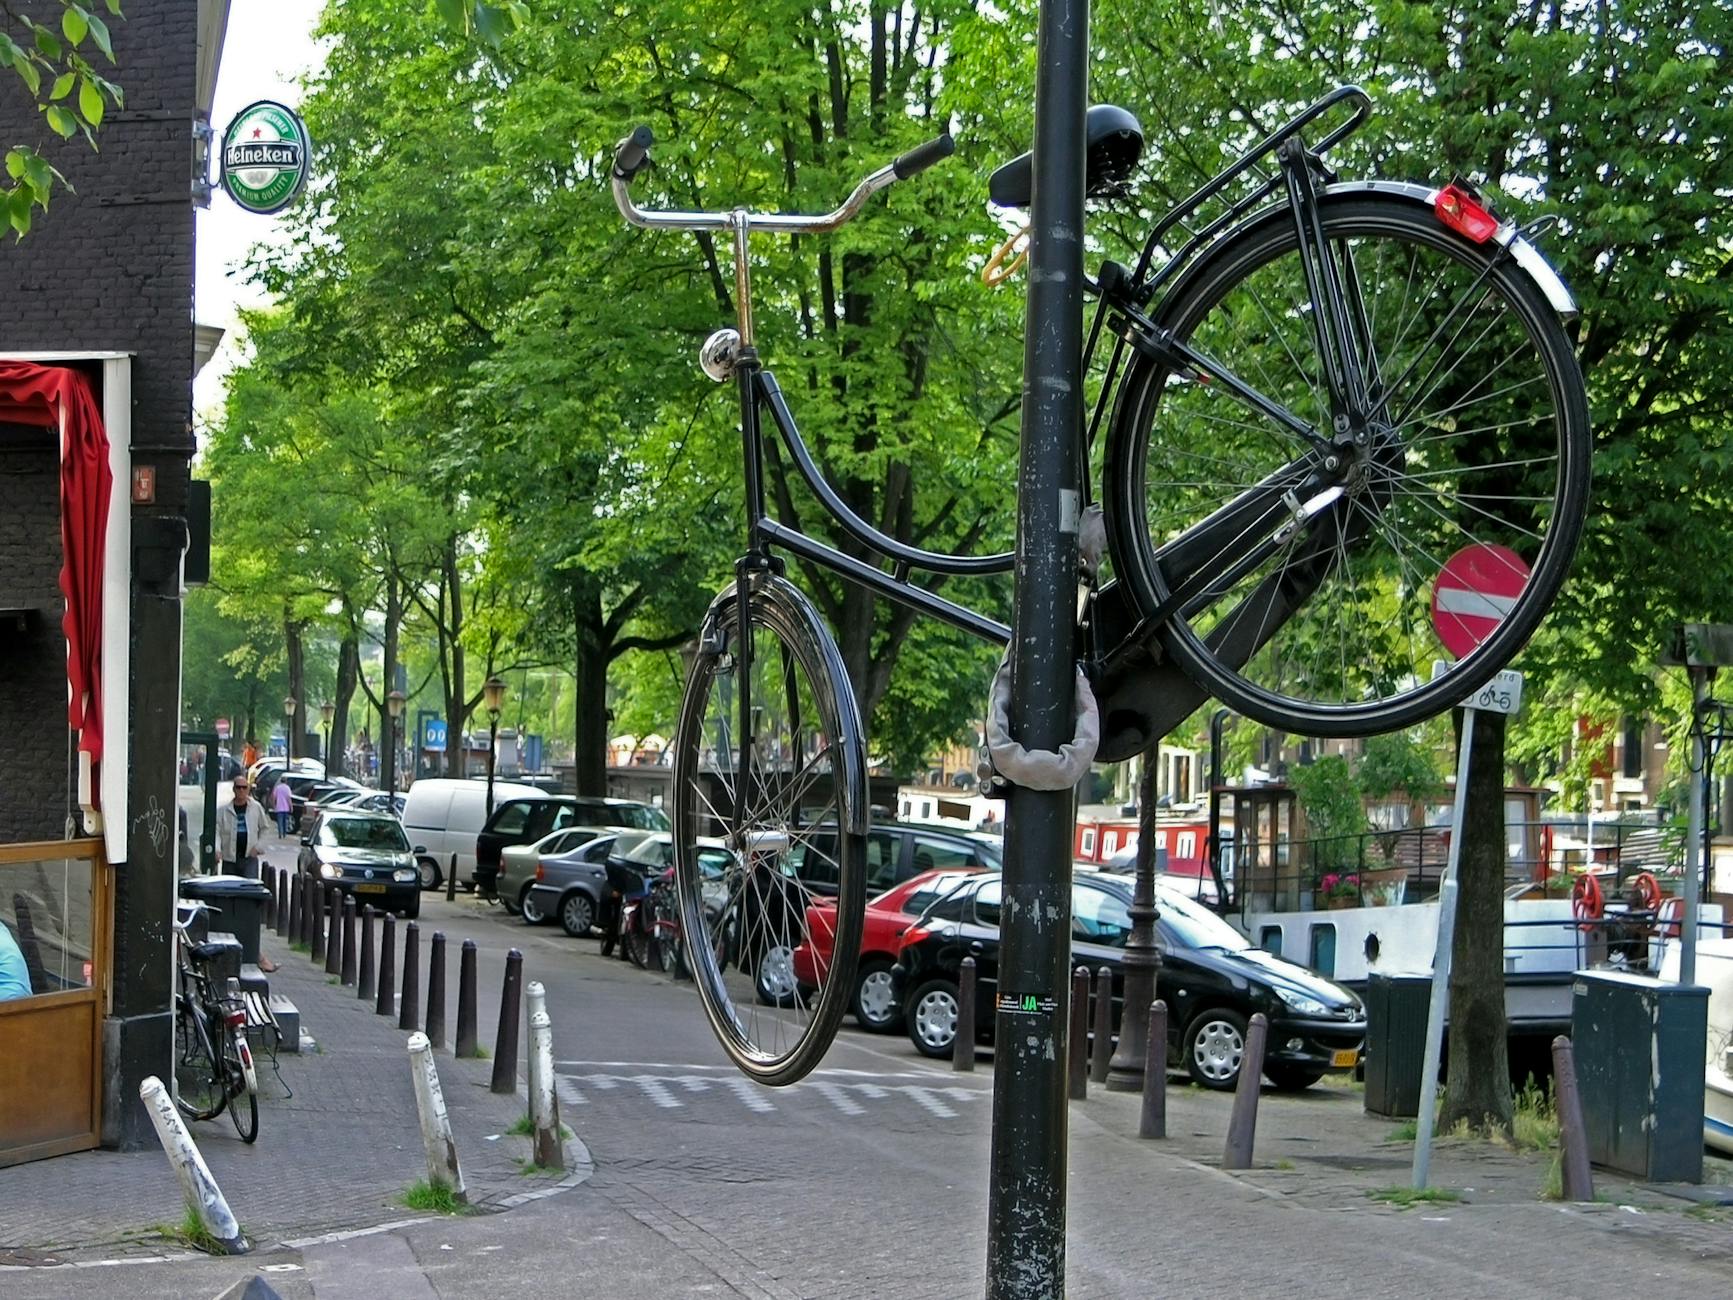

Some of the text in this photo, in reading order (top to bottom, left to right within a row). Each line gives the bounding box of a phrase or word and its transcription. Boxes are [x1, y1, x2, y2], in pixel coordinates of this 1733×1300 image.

[227, 145, 294, 166] Heineken
[233, 177, 260, 201] PREMIUM
[261, 175, 288, 201] QUALITY
[1022, 995, 1037, 1011] JA
